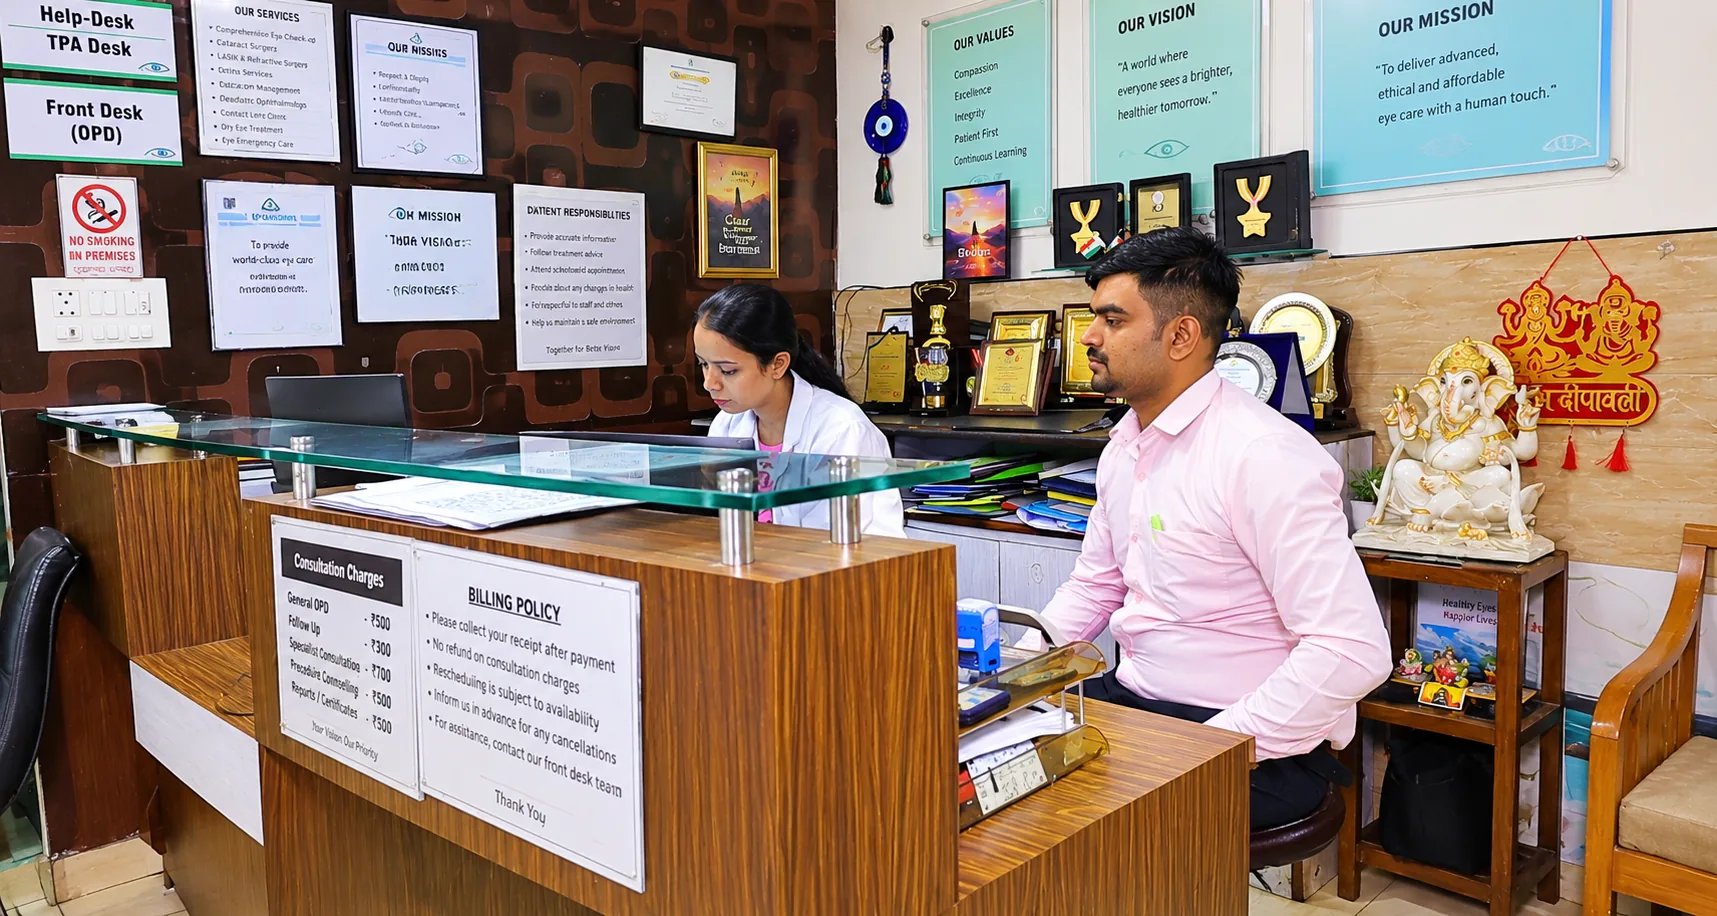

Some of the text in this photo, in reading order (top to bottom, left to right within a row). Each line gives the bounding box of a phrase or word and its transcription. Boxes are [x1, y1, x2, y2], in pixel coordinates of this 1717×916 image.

[40, 4, 135, 31] Help-Desk
[234, 5, 300, 23] OUR SERVICES
[1118, 2, 1196, 35] OUR VISION
[1378, 0, 1494, 38] OUR MISSION
[46, 34, 133, 58] TPA Desk
[954, 25, 1015, 51] OUR VALUES
[1131, 55, 1157, 70] world
[1159, 50, 1189, 64] where
[1397, 54, 1437, 72] deliver
[1438, 42, 1500, 65] advanced,
[1117, 65, 1233, 97] everyone sees a brighter,
[1378, 66, 1506, 100] ethical and affordable
[45, 99, 144, 121] Front Desk
[1117, 104, 1158, 121] healthier
[1378, 111, 1397, 125] eye
[1399, 105, 1424, 121] care
[1426, 100, 1452, 116] with
[1454, 100, 1463, 113] a
[1464, 93, 1507, 111] human
[70, 123, 123, 146] (OPD)
[982, 127, 999, 140] First
[994, 145, 1028, 159] Learning
[69, 236, 84, 246] NO
[250, 240, 262, 249] To
[85, 251, 136, 261] PREMISES
[294, 552, 384, 590] Consultation Charges
[287, 591, 391, 632] General OPD ₹500
[468, 586, 561, 622] BILLING POLICY
[311, 620, 321, 637] Up
[371, 638, 392, 658] ₹300
[431, 611, 616, 674] Please collect your receipt after payment
[371, 663, 392, 683] ₹700
[432, 637, 581, 696] No refund on consultation charges
[372, 690, 392, 709] ₹500
[488, 682, 496, 694] is
[498, 686, 533, 709] subject
[533, 697, 544, 711] to
[434, 689, 617, 765] Inform us in advance for any cancellations
[434, 714, 448, 730] For
[492, 738, 525, 761] contact
[526, 750, 542, 766] our
[544, 755, 568, 778] front
[569, 767, 593, 787] desk
[494, 789, 525, 815] Thank
